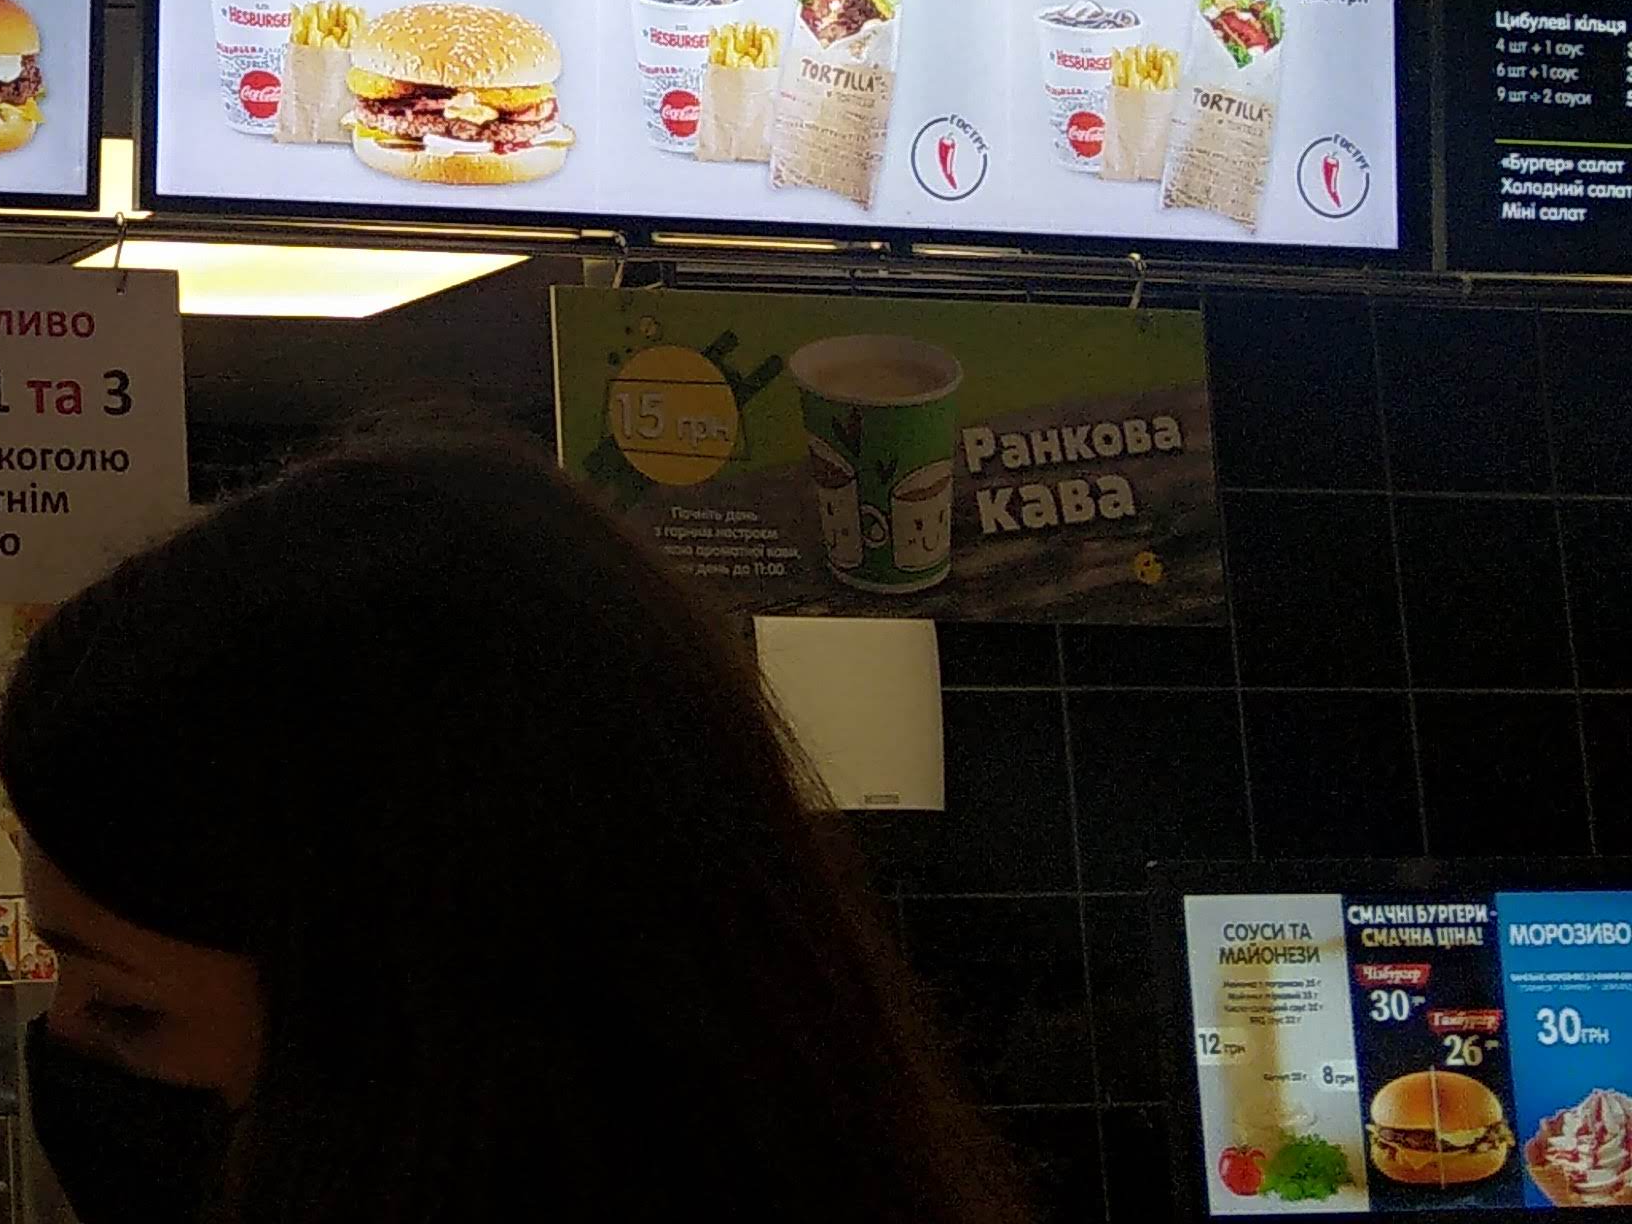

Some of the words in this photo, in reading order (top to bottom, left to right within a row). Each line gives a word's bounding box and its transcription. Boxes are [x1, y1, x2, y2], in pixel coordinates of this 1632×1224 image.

[801, 58, 877, 93] TORTILLA
[1502, 202, 1536, 220] Міні
[1540, 205, 1586, 222] салат
[28, 378, 83, 414] та
[102, 369, 133, 416] 3
[615, 393, 664, 440] 15
[677, 412, 729, 444] грн
[962, 411, 1182, 474] Ранкова
[976, 474, 1135, 536] кава
[1348, 905, 1414, 924] СМАЧНІ
[1420, 904, 1488, 922] БУРГЕРИ
[1224, 923, 1283, 941] СОУСИ
[1289, 923, 1312, 940] ТА
[1361, 928, 1434, 947] СМАЧНА
[1438, 928, 1484, 949] ЦІНА!
[1510, 923, 1632, 946] МОРОЗИВО
[1219, 943, 1319, 965] МАЙОНЕЗИ
[1371, 990, 1409, 1021] 30
[1537, 1008, 1580, 1045] 30
[1581, 1028, 1609, 1045] ГРН
